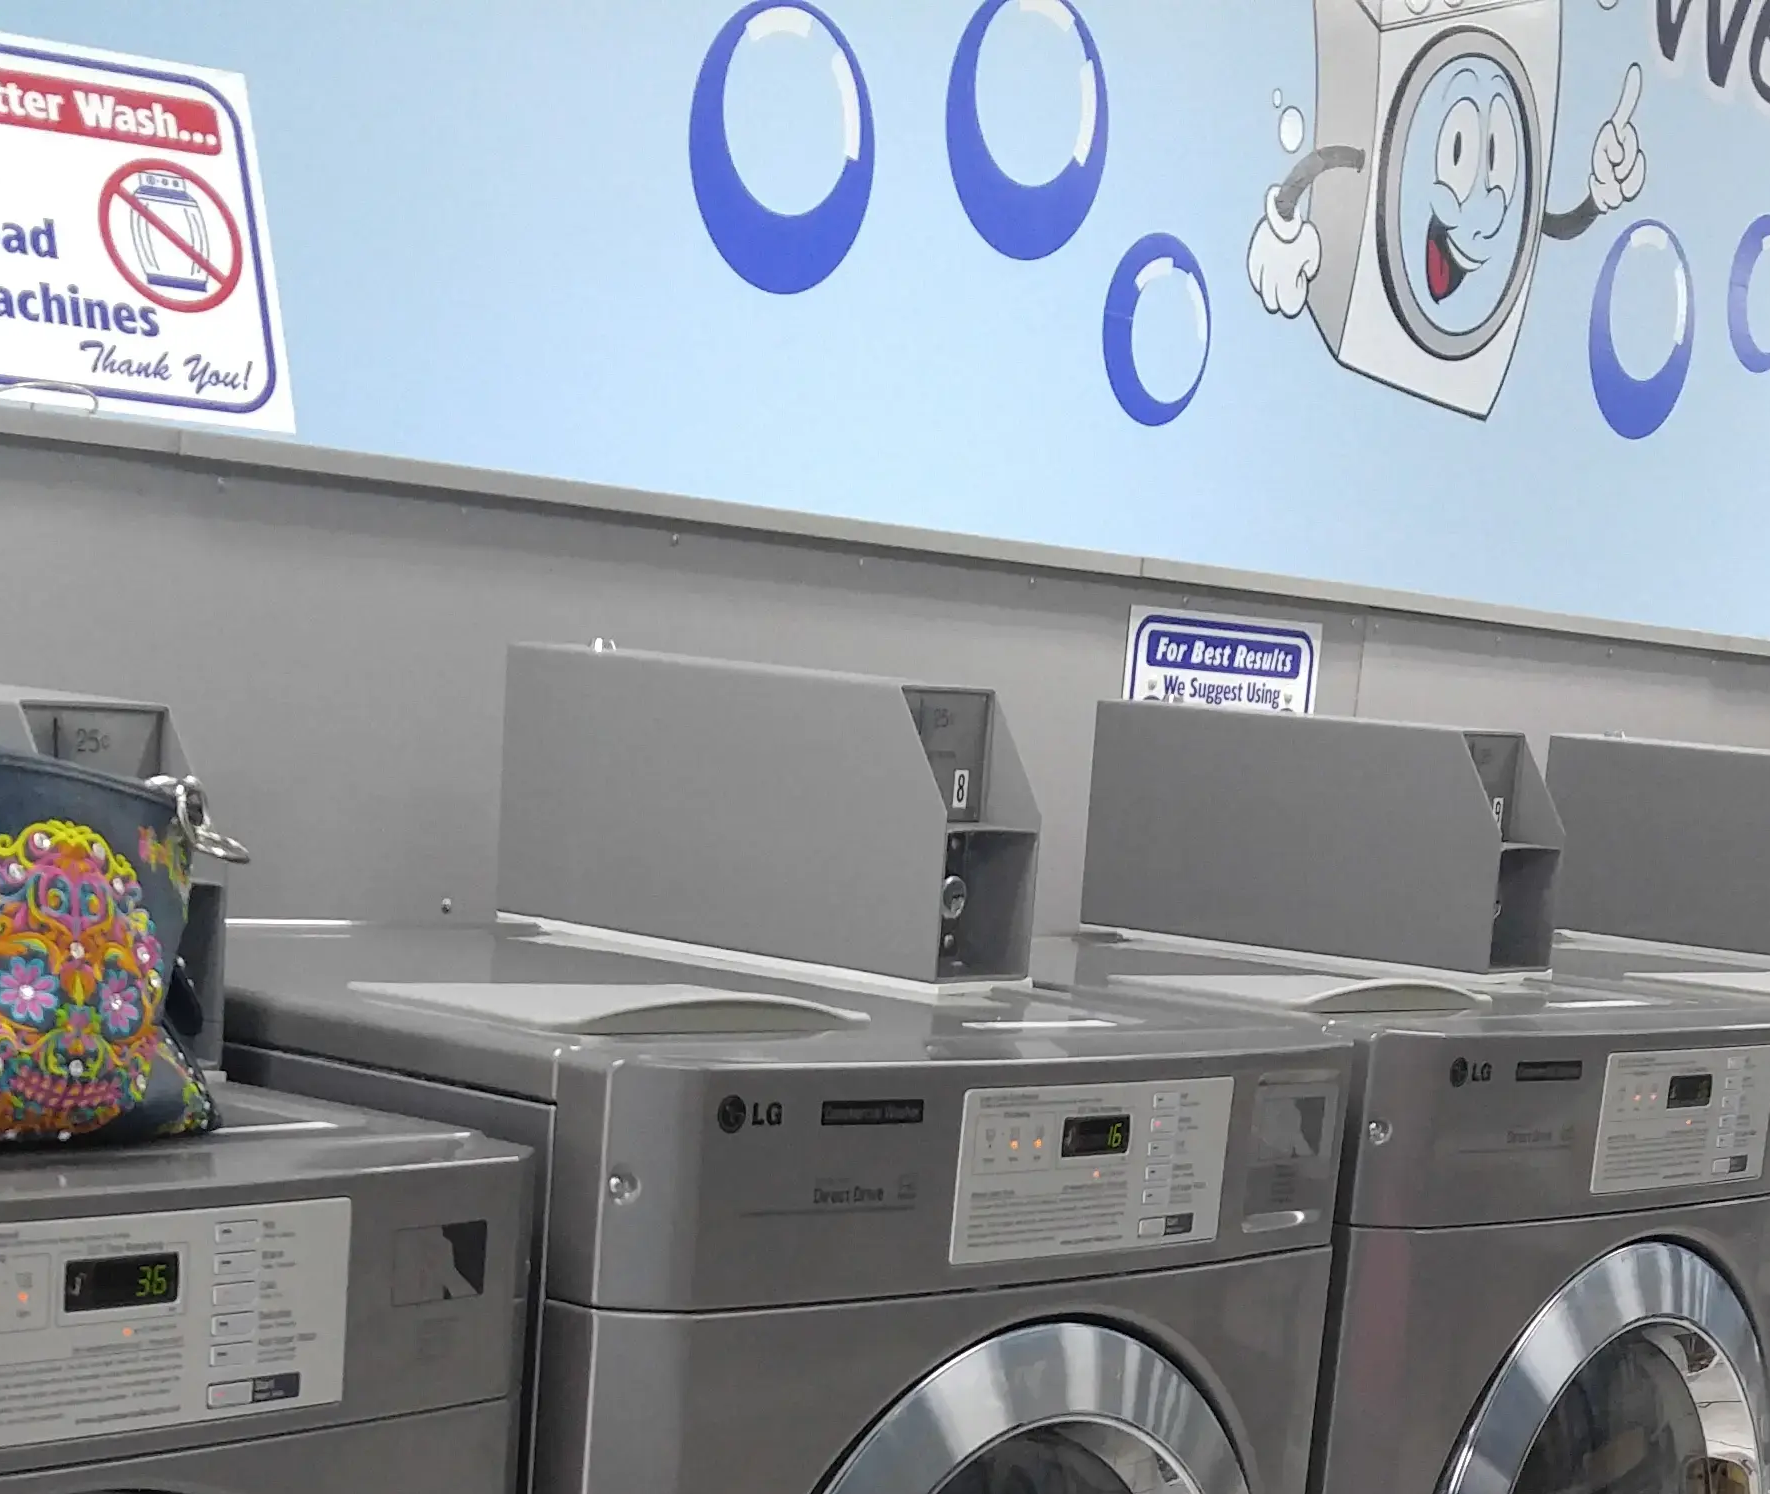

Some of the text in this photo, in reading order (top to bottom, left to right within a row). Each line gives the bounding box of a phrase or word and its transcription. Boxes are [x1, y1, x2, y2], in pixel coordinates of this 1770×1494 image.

[74, 91, 218, 147] Wash...
[80, 341, 252, 394] Thank You!
[1156, 636, 1294, 673] For Best Results
[1163, 675, 1281, 709] We Suggest Using
[957, 774, 965, 803] 8
[1471, 1060, 1492, 1082] LG
[752, 1101, 783, 1126] LG
[1107, 1122, 1122, 1148] 16
[135, 1264, 167, 1297] 36
